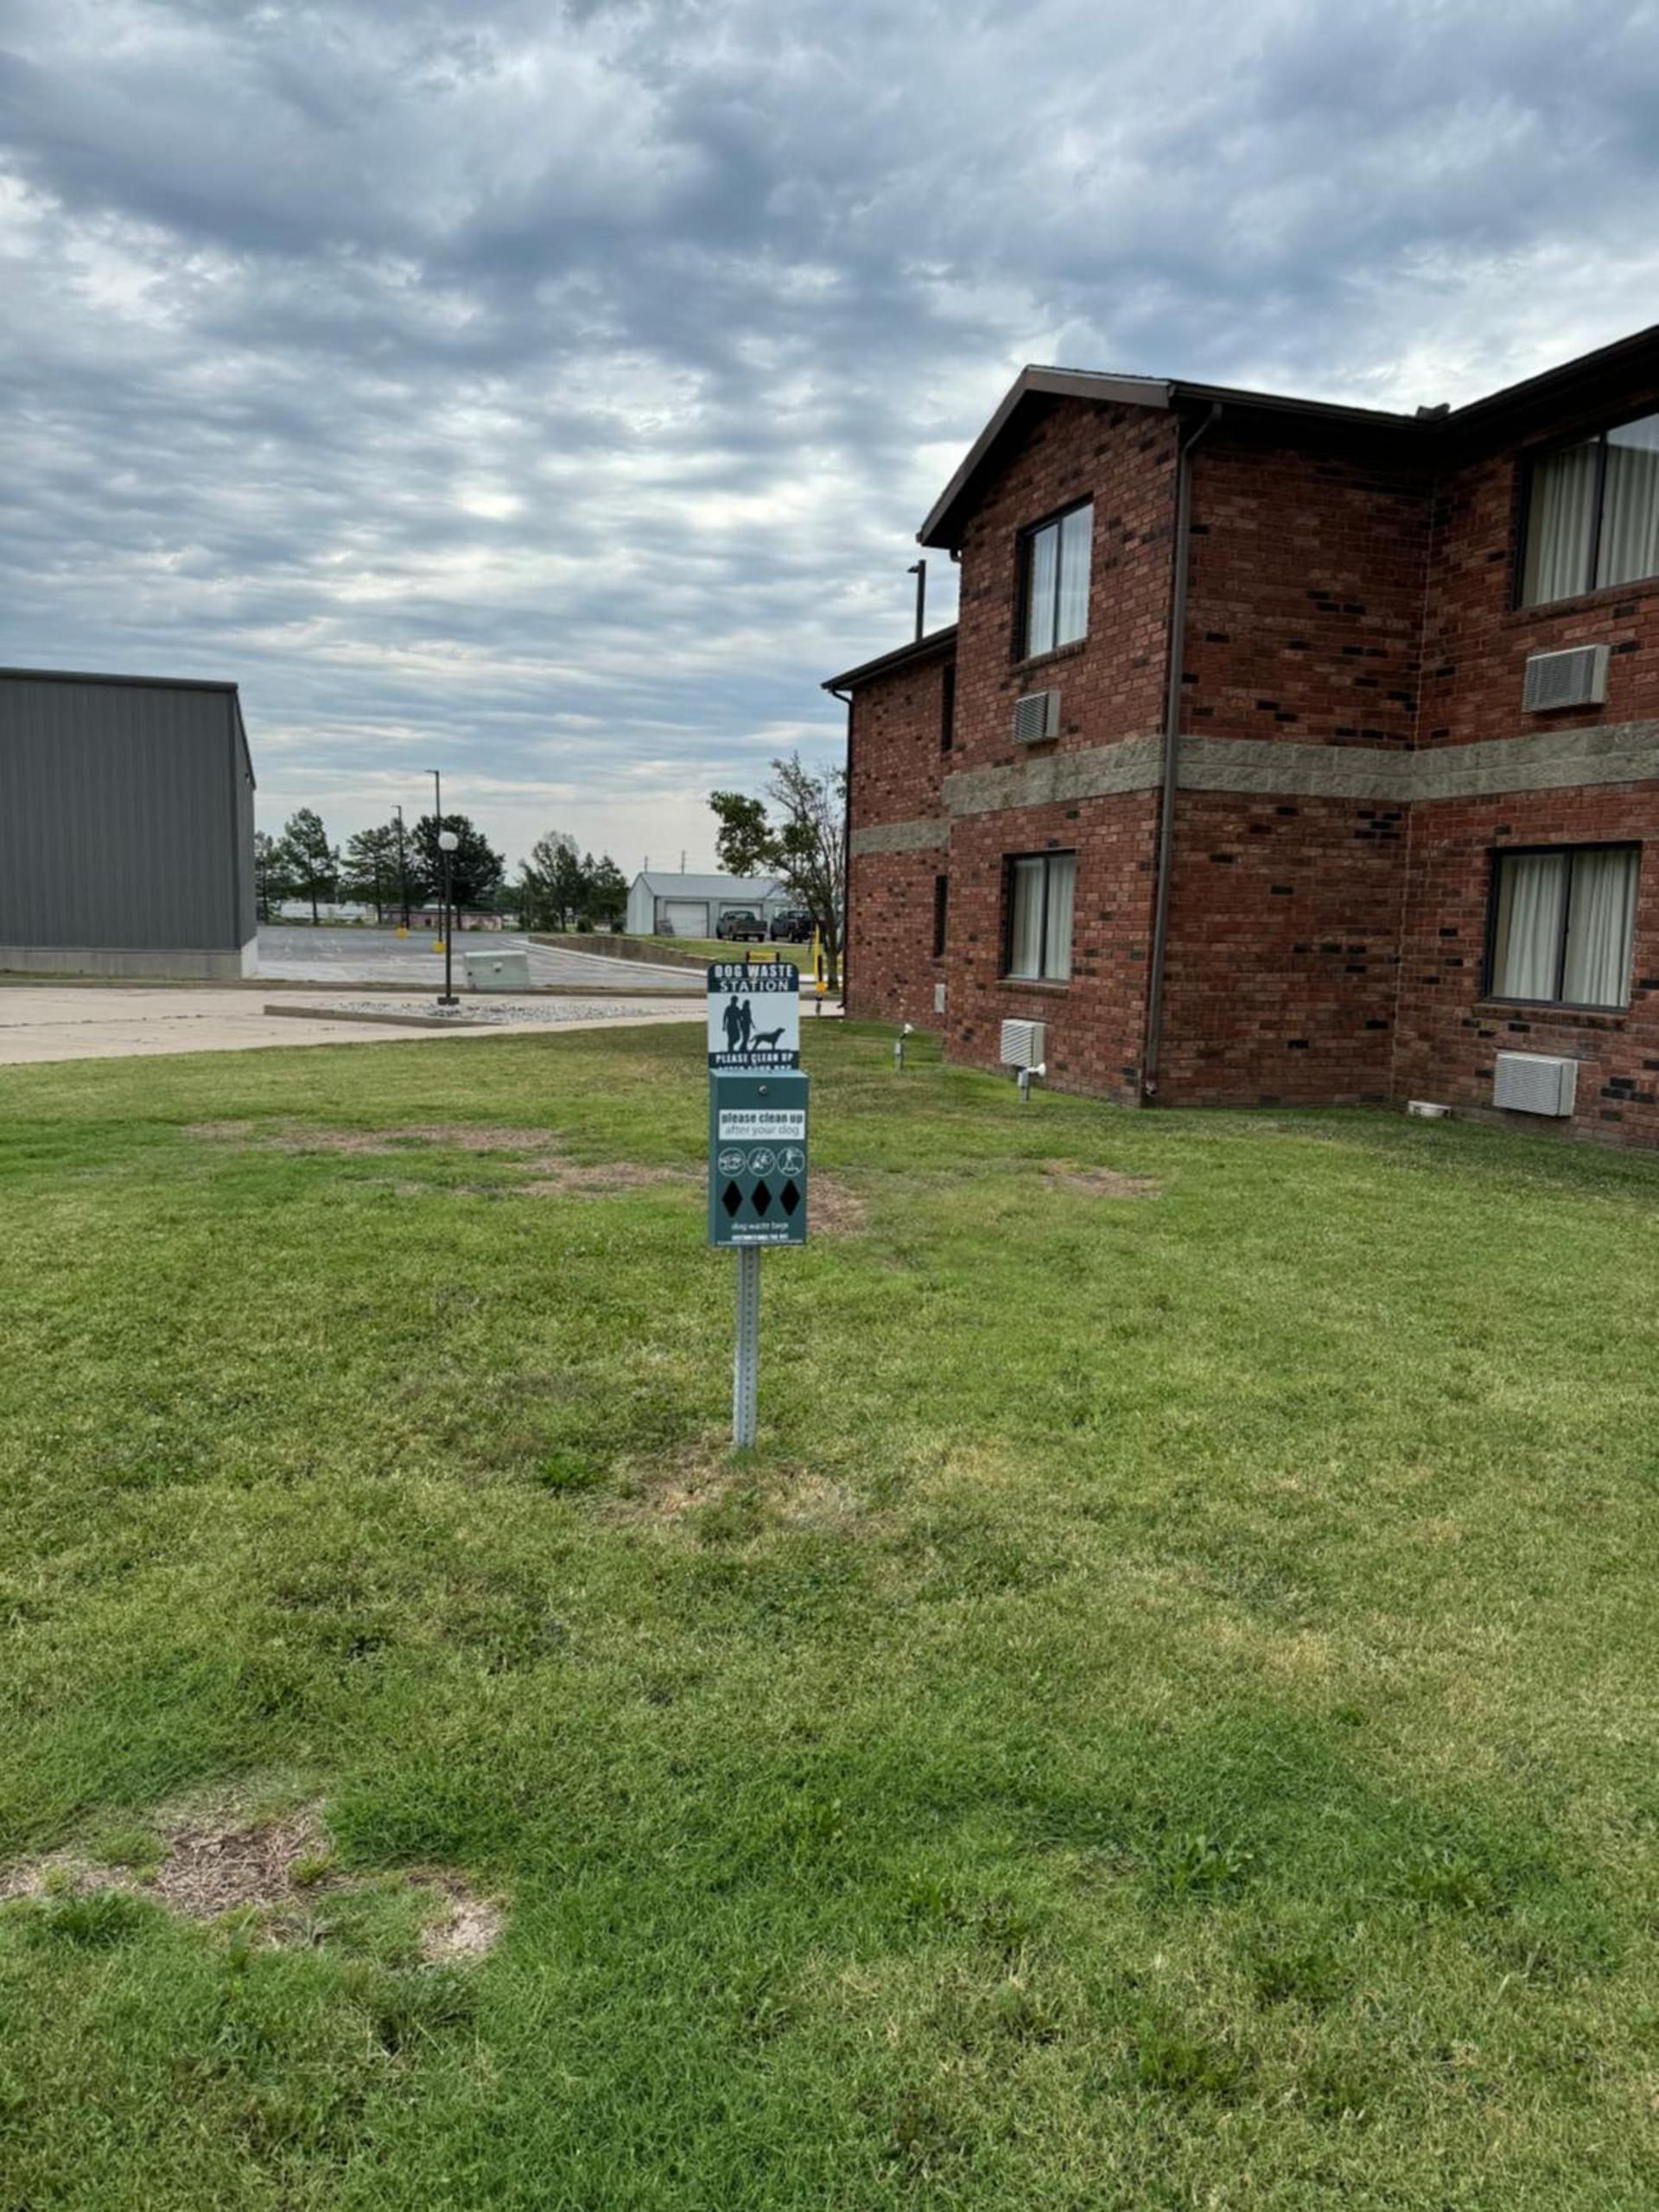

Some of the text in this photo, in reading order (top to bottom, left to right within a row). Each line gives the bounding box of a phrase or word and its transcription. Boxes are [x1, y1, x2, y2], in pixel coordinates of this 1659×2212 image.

[715, 965, 793, 978] DOG WASTE
[719, 981, 789, 993] STATION
[715, 1052, 794, 1064] PLEASE CLEAN UP
[721, 1112, 804, 1125] please clean up
[726, 1125, 800, 1137] after your dog
